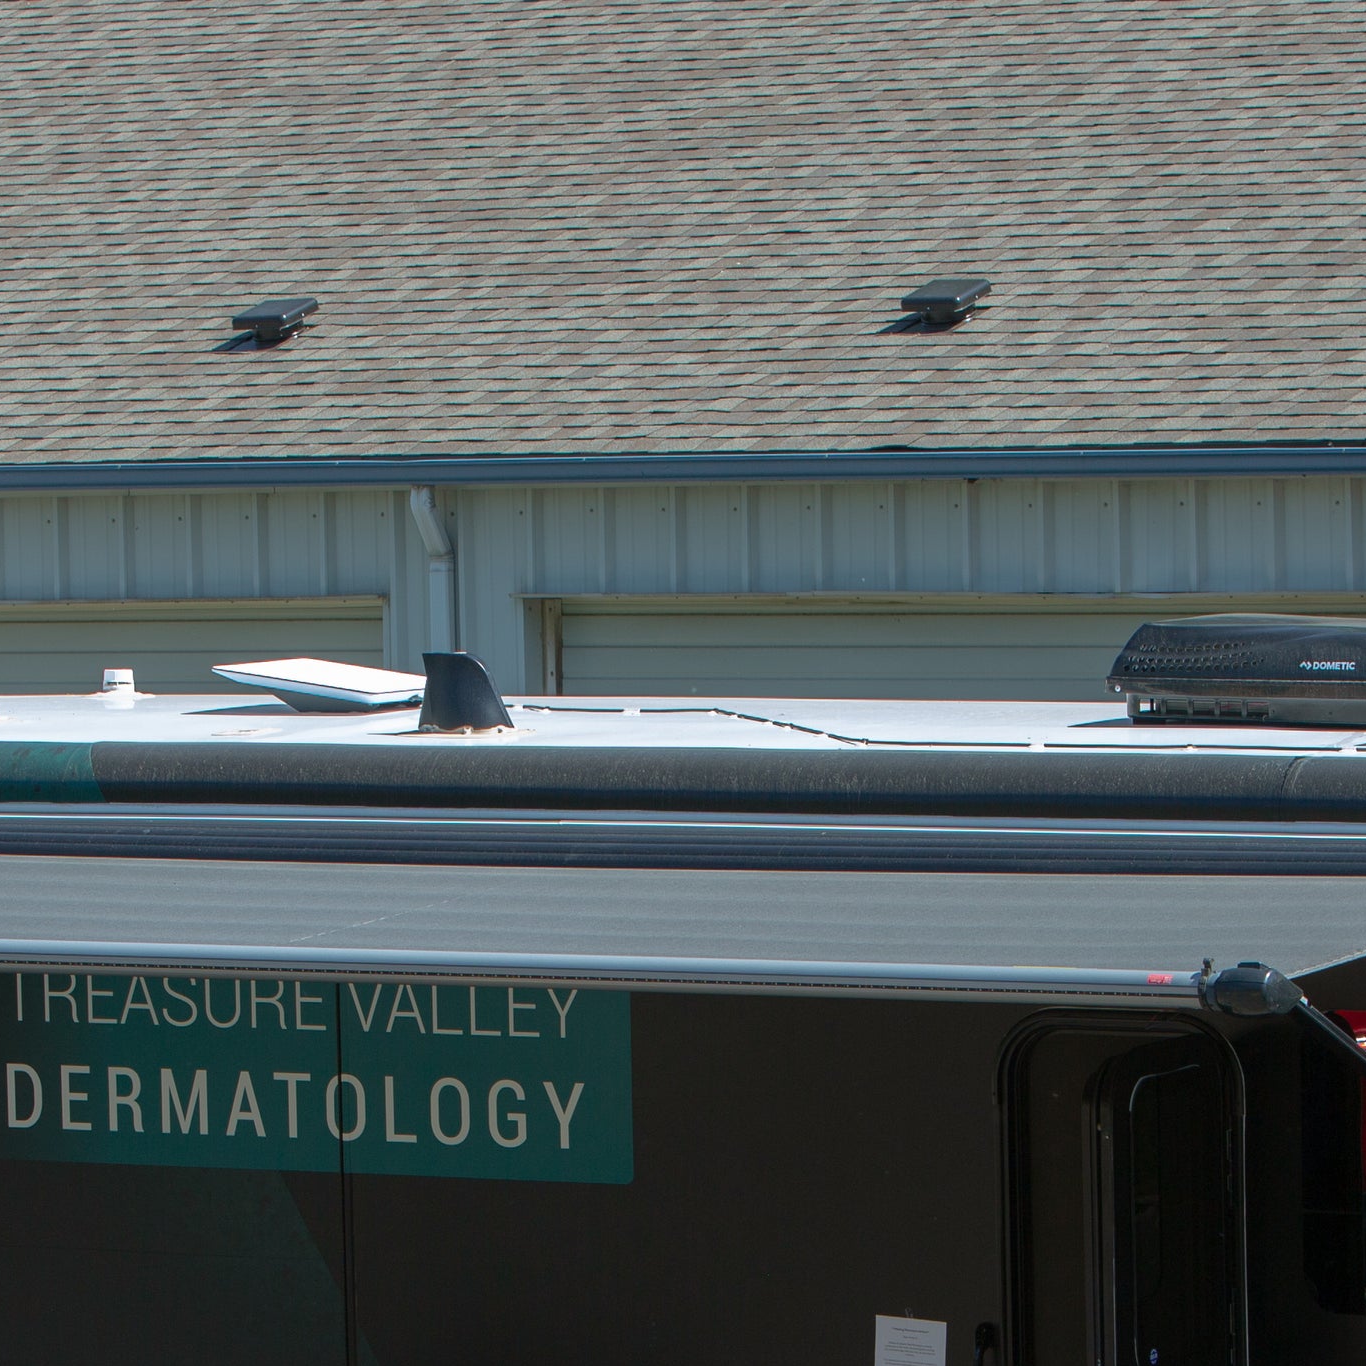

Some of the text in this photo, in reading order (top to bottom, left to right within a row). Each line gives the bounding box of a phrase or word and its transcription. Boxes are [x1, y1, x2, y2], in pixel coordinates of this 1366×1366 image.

[1313, 661, 1355, 671] DOMETIC
[348, 983, 578, 1038] VALLEY
[6, 1063, 585, 1149] DERMATOLOGY
